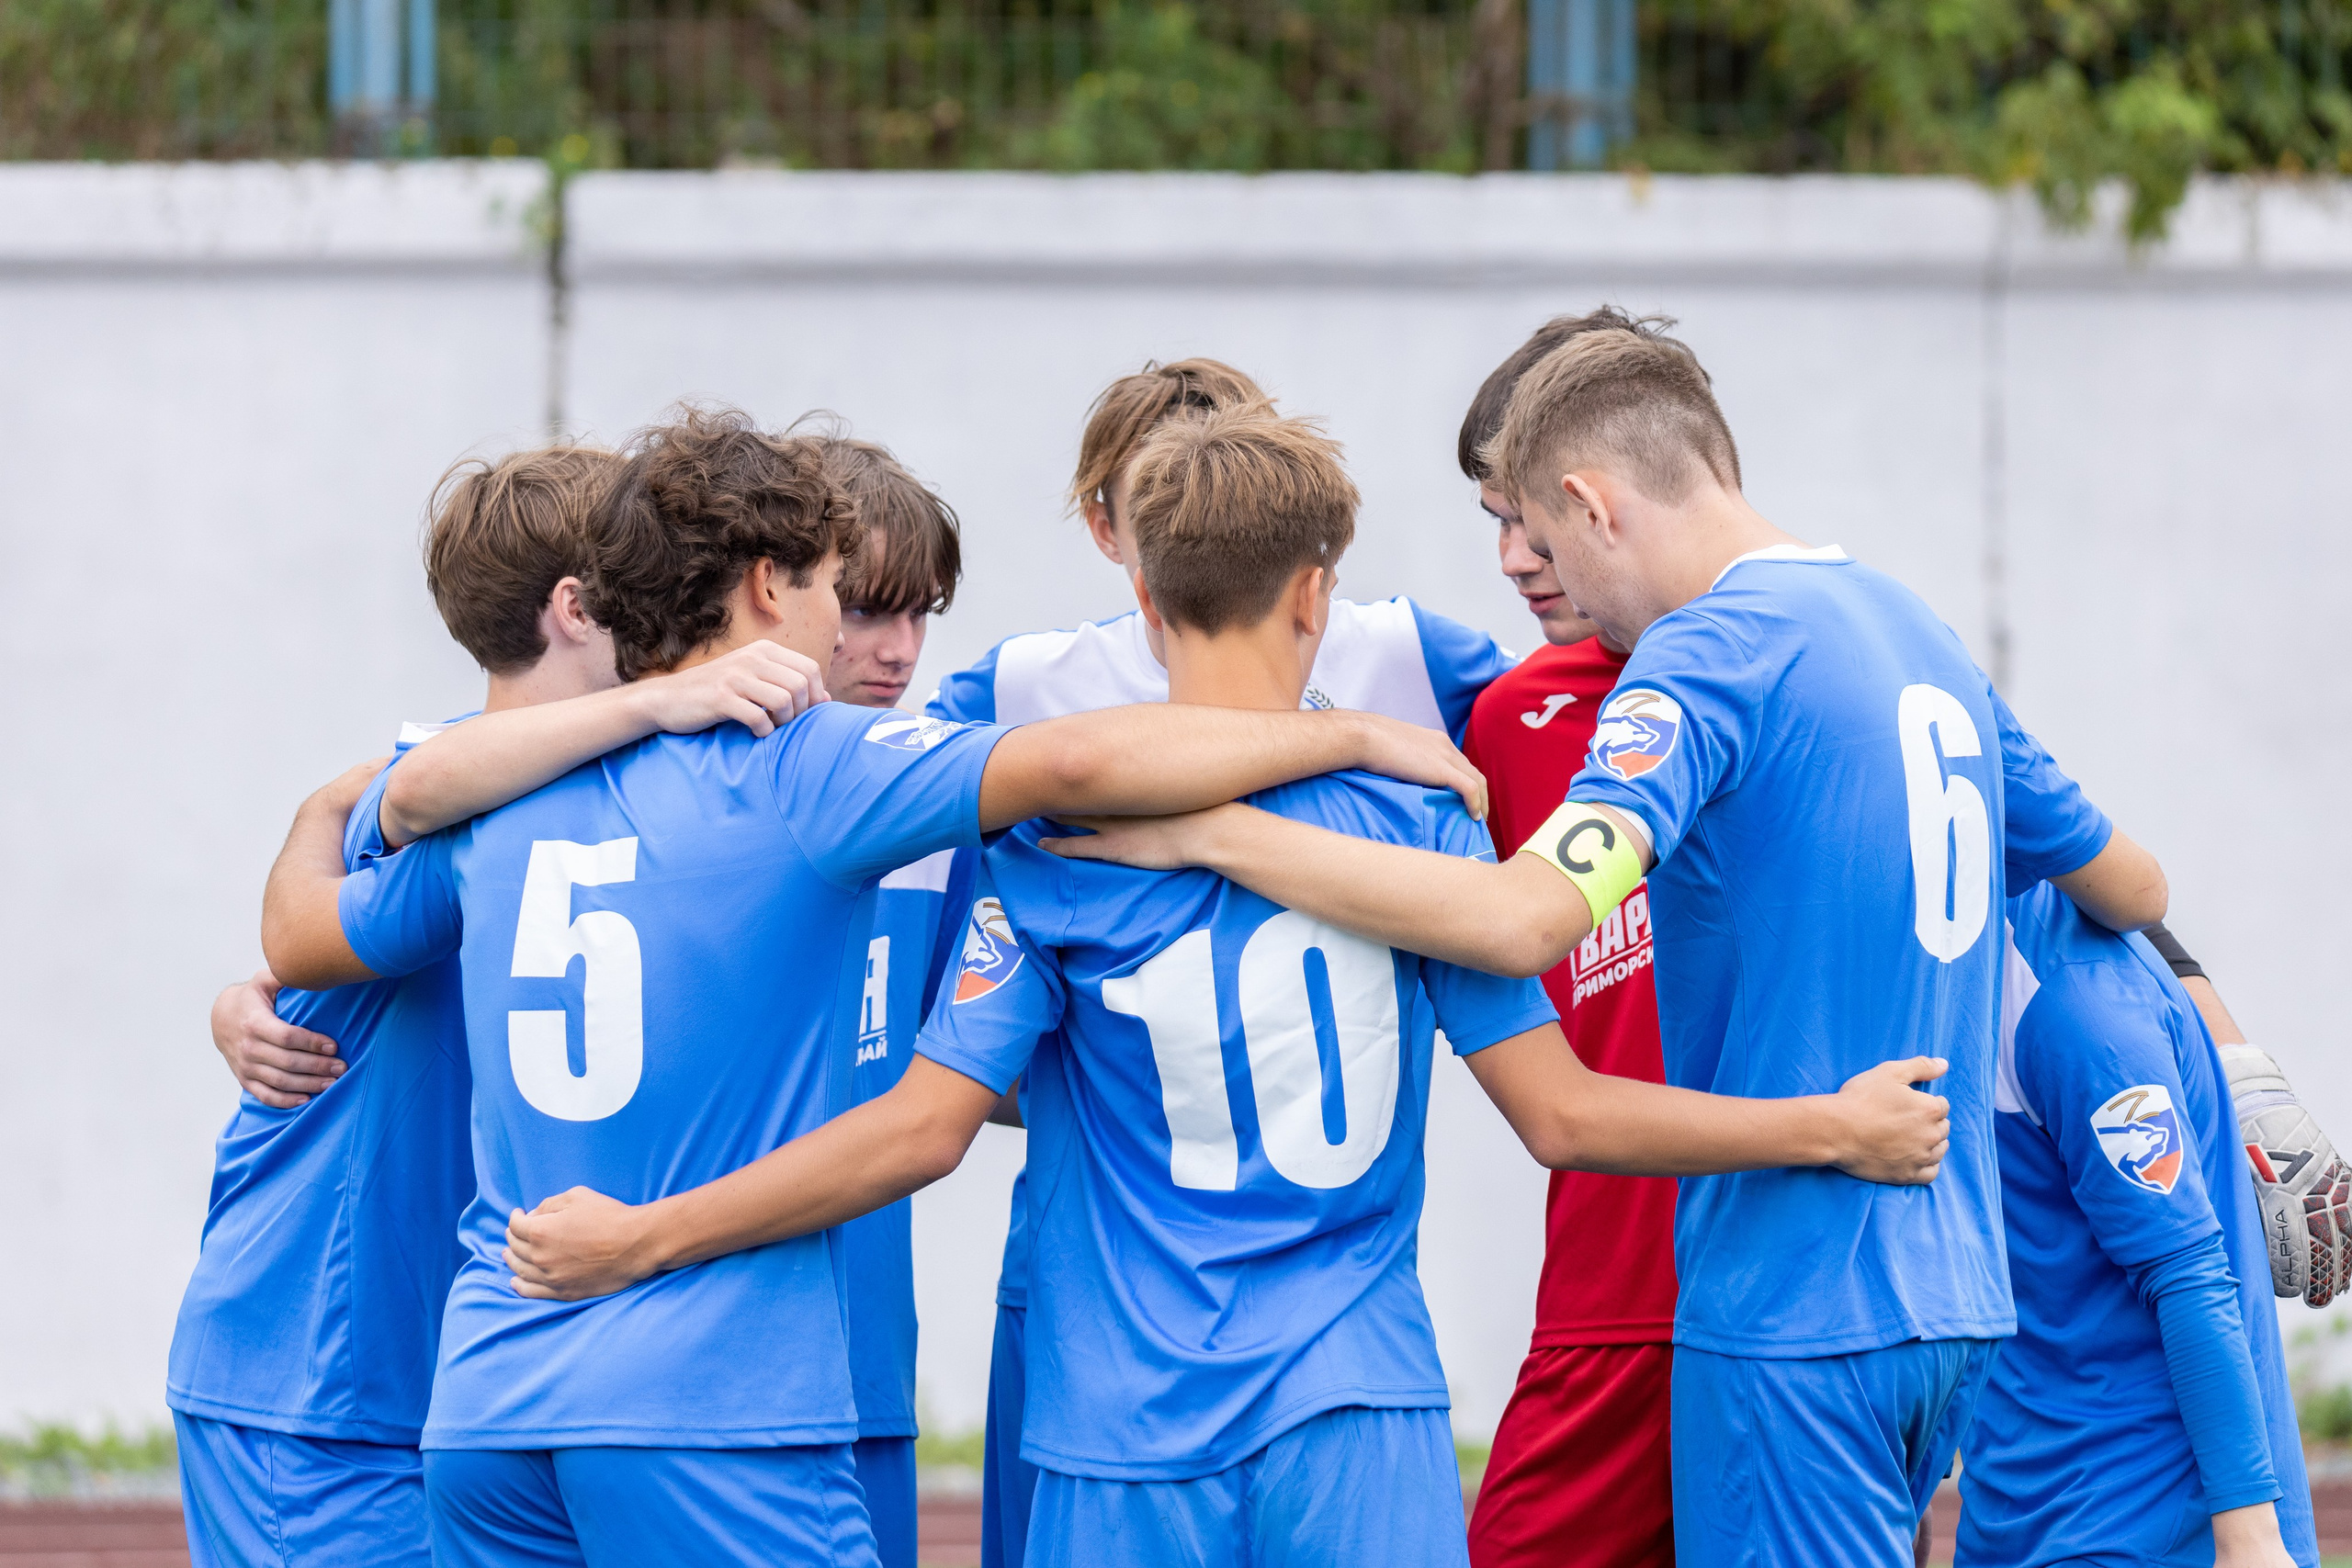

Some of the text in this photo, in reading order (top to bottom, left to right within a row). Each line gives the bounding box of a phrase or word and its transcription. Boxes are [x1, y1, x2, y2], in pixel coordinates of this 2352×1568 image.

[1556, 818, 1615, 874] C
[1898, 683, 1990, 963] 6
[508, 836, 643, 1122] 5
[1102, 908, 1399, 1190] 10
[2275, 1209, 2293, 1287] ALPHA
